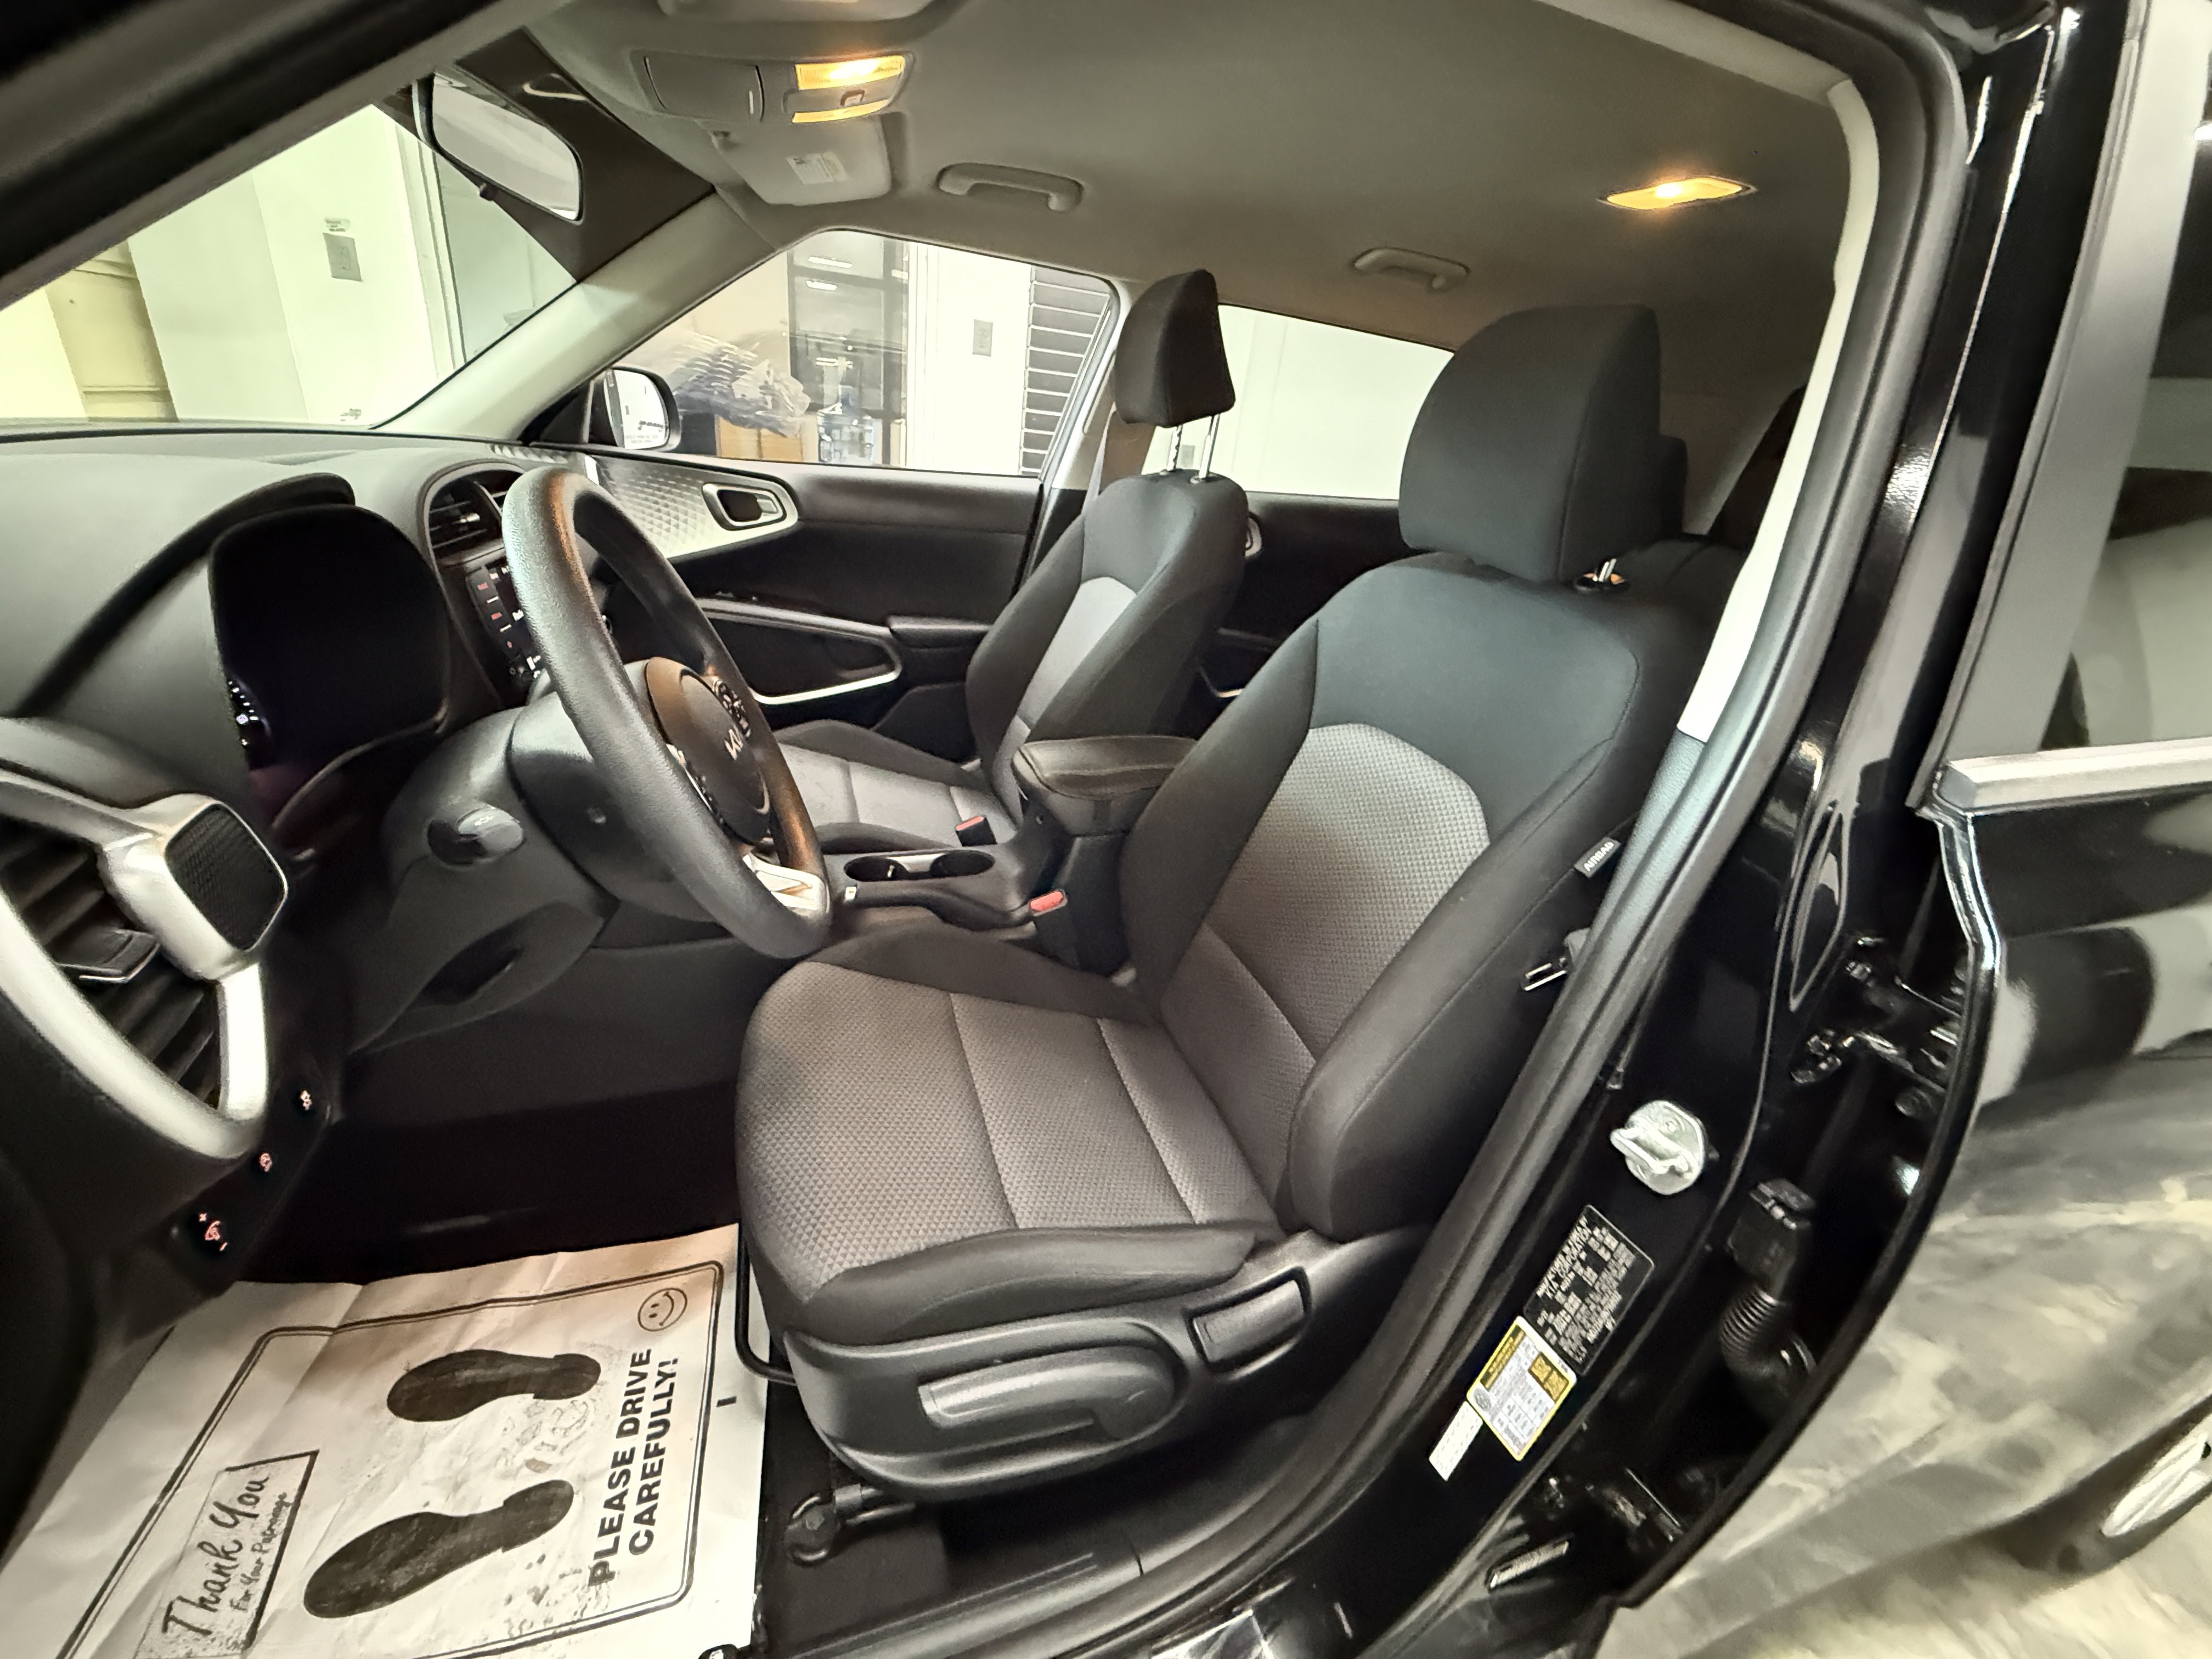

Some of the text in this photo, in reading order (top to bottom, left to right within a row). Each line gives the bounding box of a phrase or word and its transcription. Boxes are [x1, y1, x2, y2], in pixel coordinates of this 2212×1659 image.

[251, 1492, 291, 1553] Patronage
[589, 1349, 651, 1587] PLEASE DRIVE
[629, 1358, 679, 1556] CAREFULLY!
[162, 1477, 269, 1635] Thank You
[240, 1557, 264, 1584] Your
